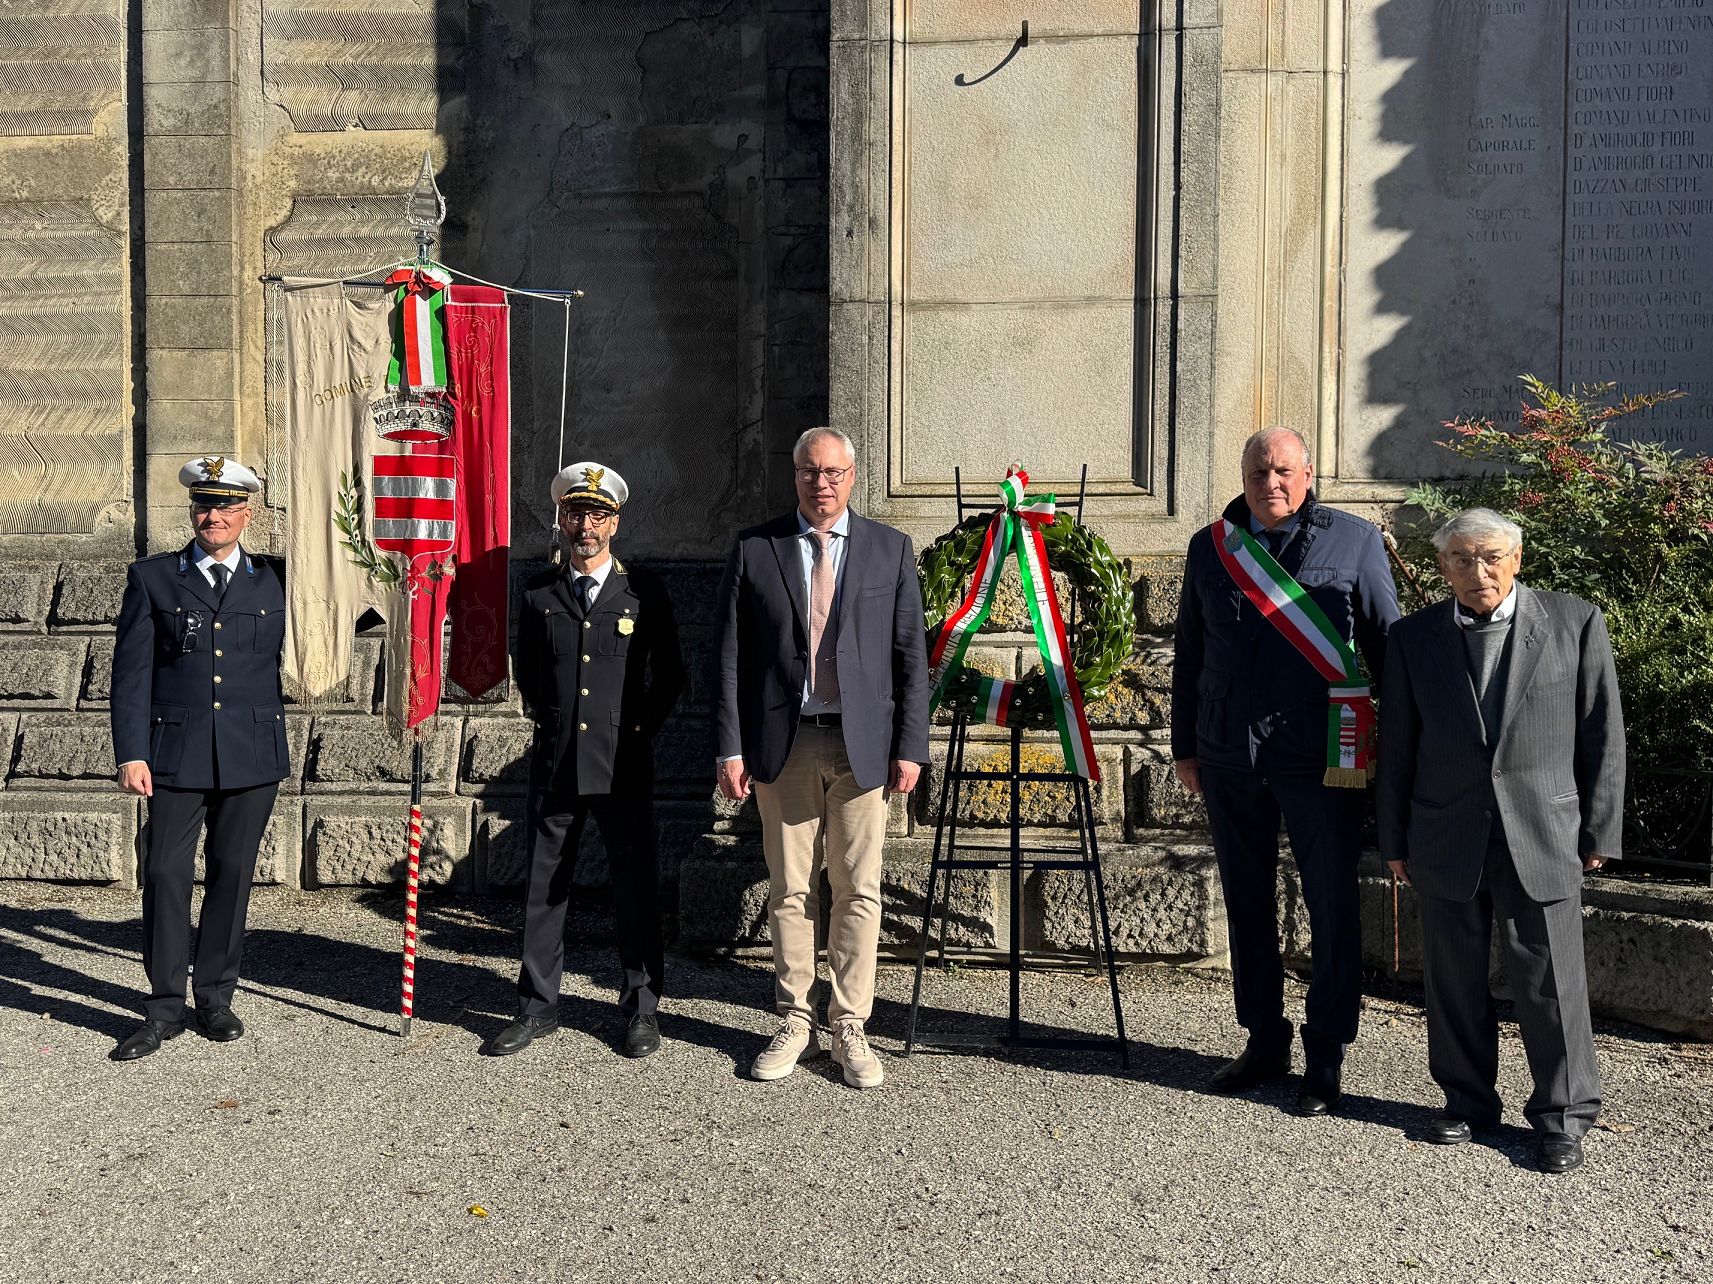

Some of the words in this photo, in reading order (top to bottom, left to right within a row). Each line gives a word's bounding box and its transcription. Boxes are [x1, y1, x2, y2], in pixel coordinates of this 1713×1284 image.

[1575, 87, 1630, 103] COMAND
[1637, 85, 1673, 102] FIORI
[1501, 113, 1540, 129] MAGG.
[1467, 138, 1536, 152] CAPORALE
[1661, 130, 1695, 147] FIORI
[1467, 162, 1524, 176] SOLDATO
[1573, 178, 1627, 194] DAZZAN
[1635, 176, 1702, 193] GIUSEPPE
[1632, 222, 1694, 239] GIOVANNI
